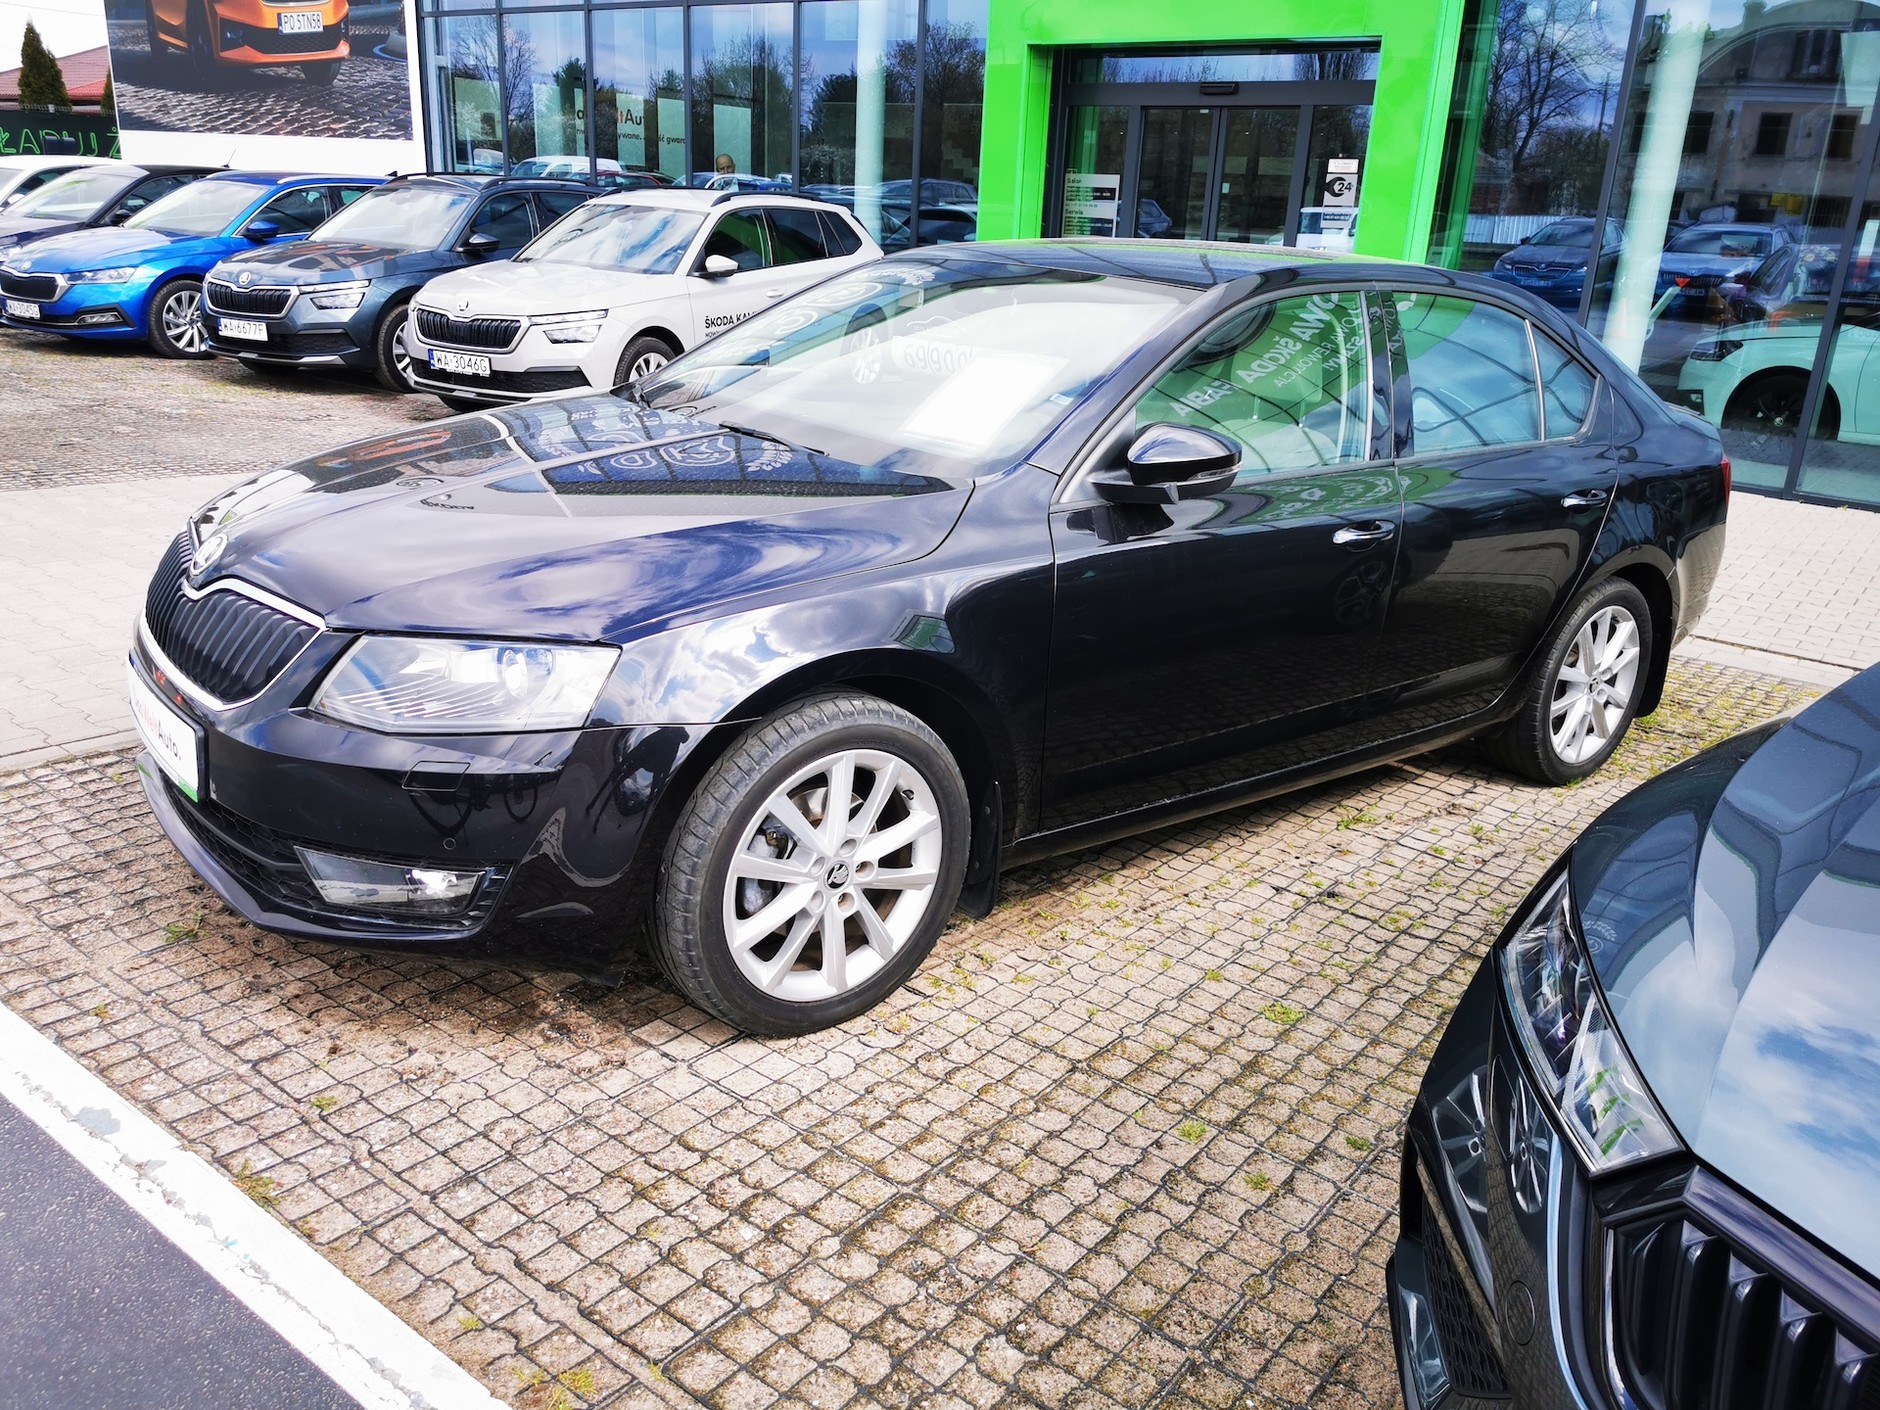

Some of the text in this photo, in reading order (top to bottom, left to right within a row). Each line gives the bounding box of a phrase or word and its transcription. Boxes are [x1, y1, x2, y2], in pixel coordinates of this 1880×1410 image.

[236, 321, 264, 336] 6677F
[704, 315, 734, 329] ŠKODA
[452, 354, 487, 372] 3046G
